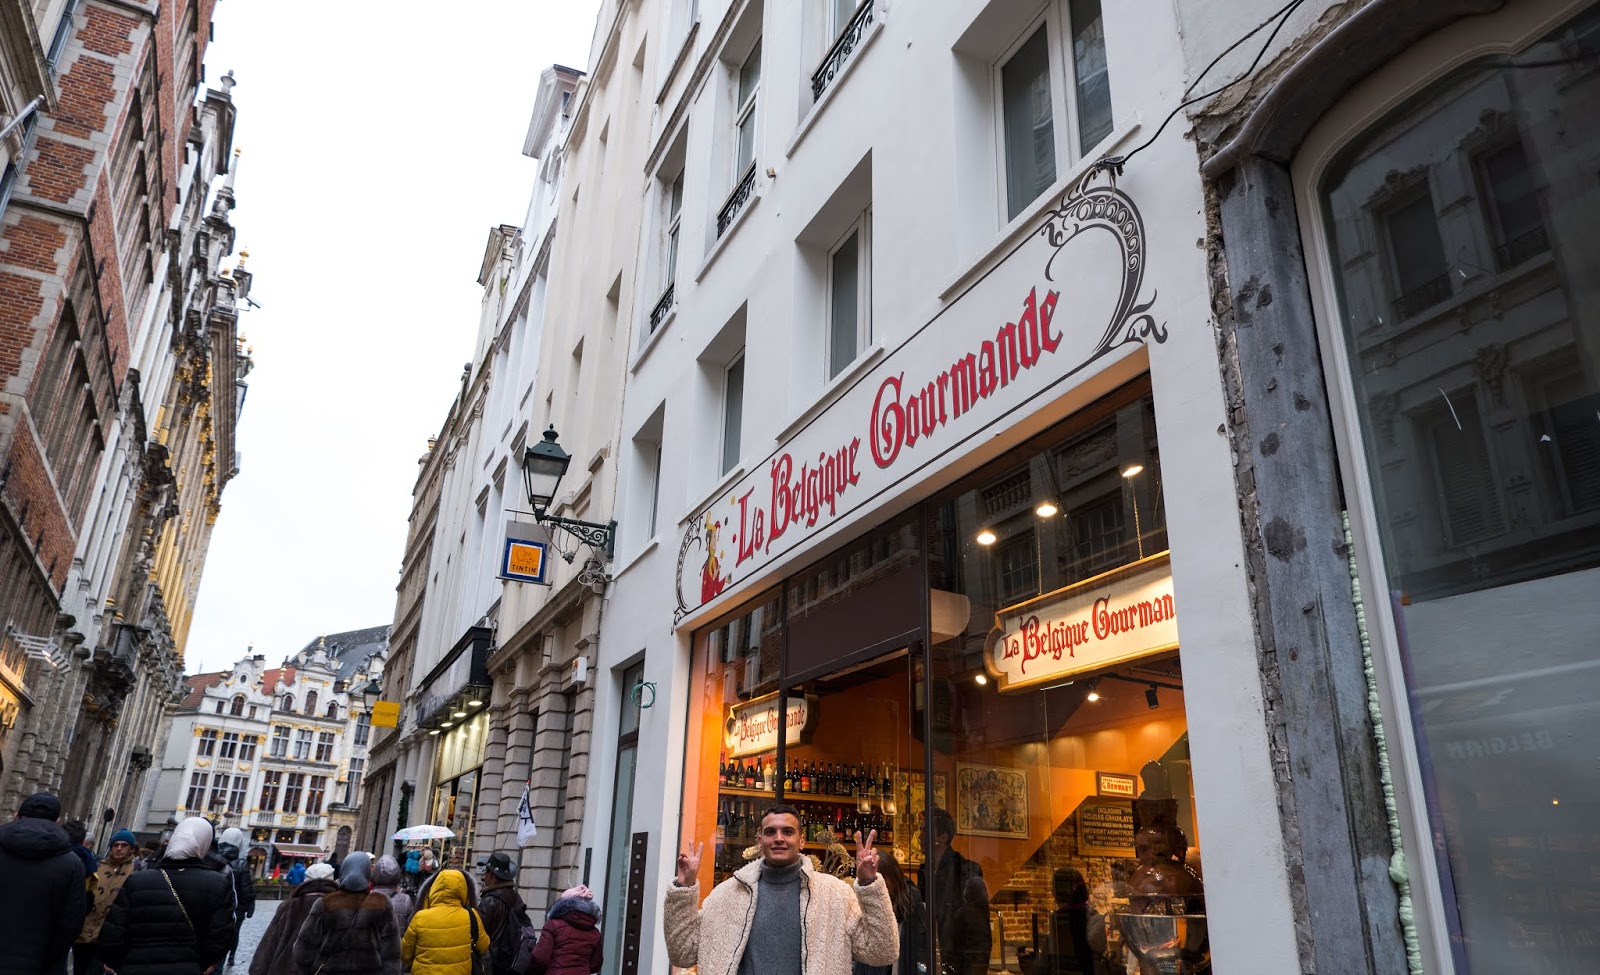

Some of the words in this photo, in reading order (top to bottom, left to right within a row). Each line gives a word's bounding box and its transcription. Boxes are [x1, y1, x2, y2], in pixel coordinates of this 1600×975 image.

[735, 486, 764, 569] La
[765, 436, 861, 555] Belgique
[869, 286, 1064, 469] Gourmande
[512, 564, 537, 574] TINTIN
[1002, 634, 1020, 660] La
[1019, 615, 1090, 674] Belgique
[1092, 593, 1176, 641] Gourman
[733, 720, 740, 737] La
[740, 710, 767, 747] Belgique
